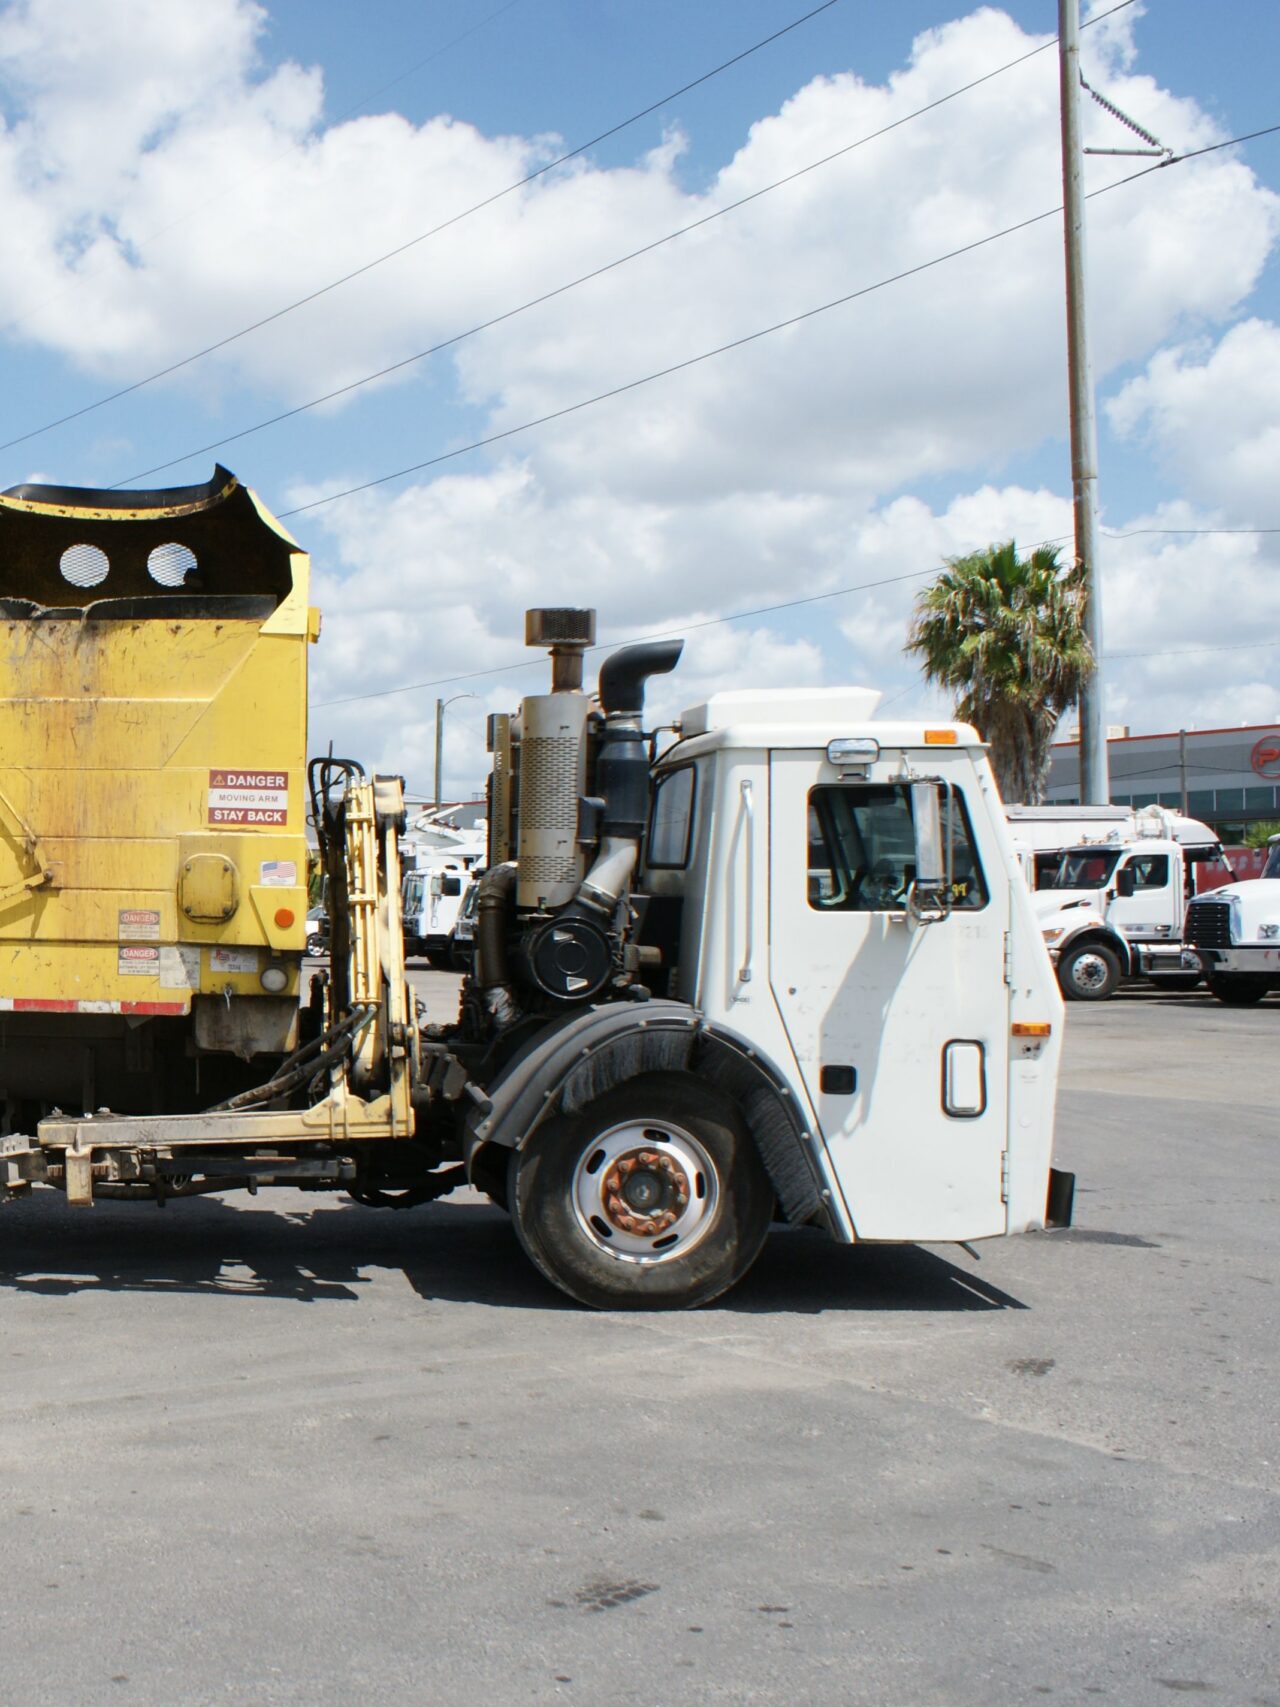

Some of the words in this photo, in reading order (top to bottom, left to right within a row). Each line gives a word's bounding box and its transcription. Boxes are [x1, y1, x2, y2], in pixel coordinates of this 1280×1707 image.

[227, 775, 285, 787] DANGER
[219, 794, 256, 802] MOVING
[258, 795, 279, 803] ARM
[214, 809, 245, 821] STAY
[247, 811, 282, 822] BACK
[123, 913, 155, 923] DANGER
[122, 949, 155, 958] DANGER
